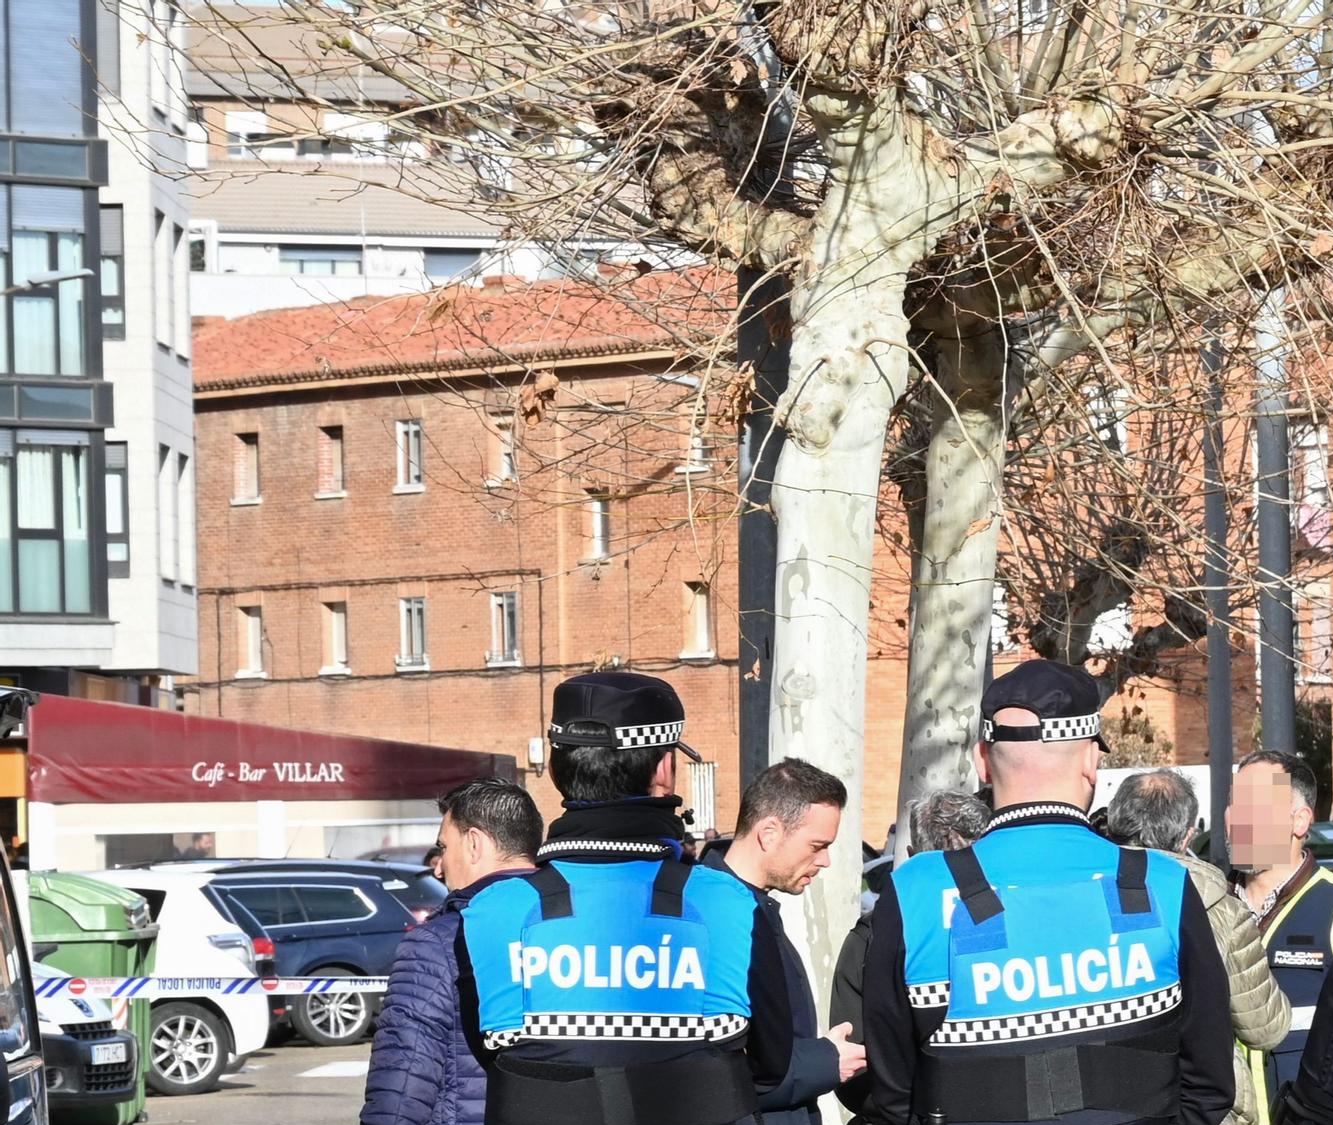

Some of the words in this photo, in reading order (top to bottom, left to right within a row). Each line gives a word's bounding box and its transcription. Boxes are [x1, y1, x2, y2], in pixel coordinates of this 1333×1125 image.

[191, 761, 225, 788] Café
[238, 762, 266, 782] Bar
[273, 762, 345, 783] VILLAR
[522, 934, 706, 989] POLICÍA
[971, 933, 1156, 1005] POLICÍA
